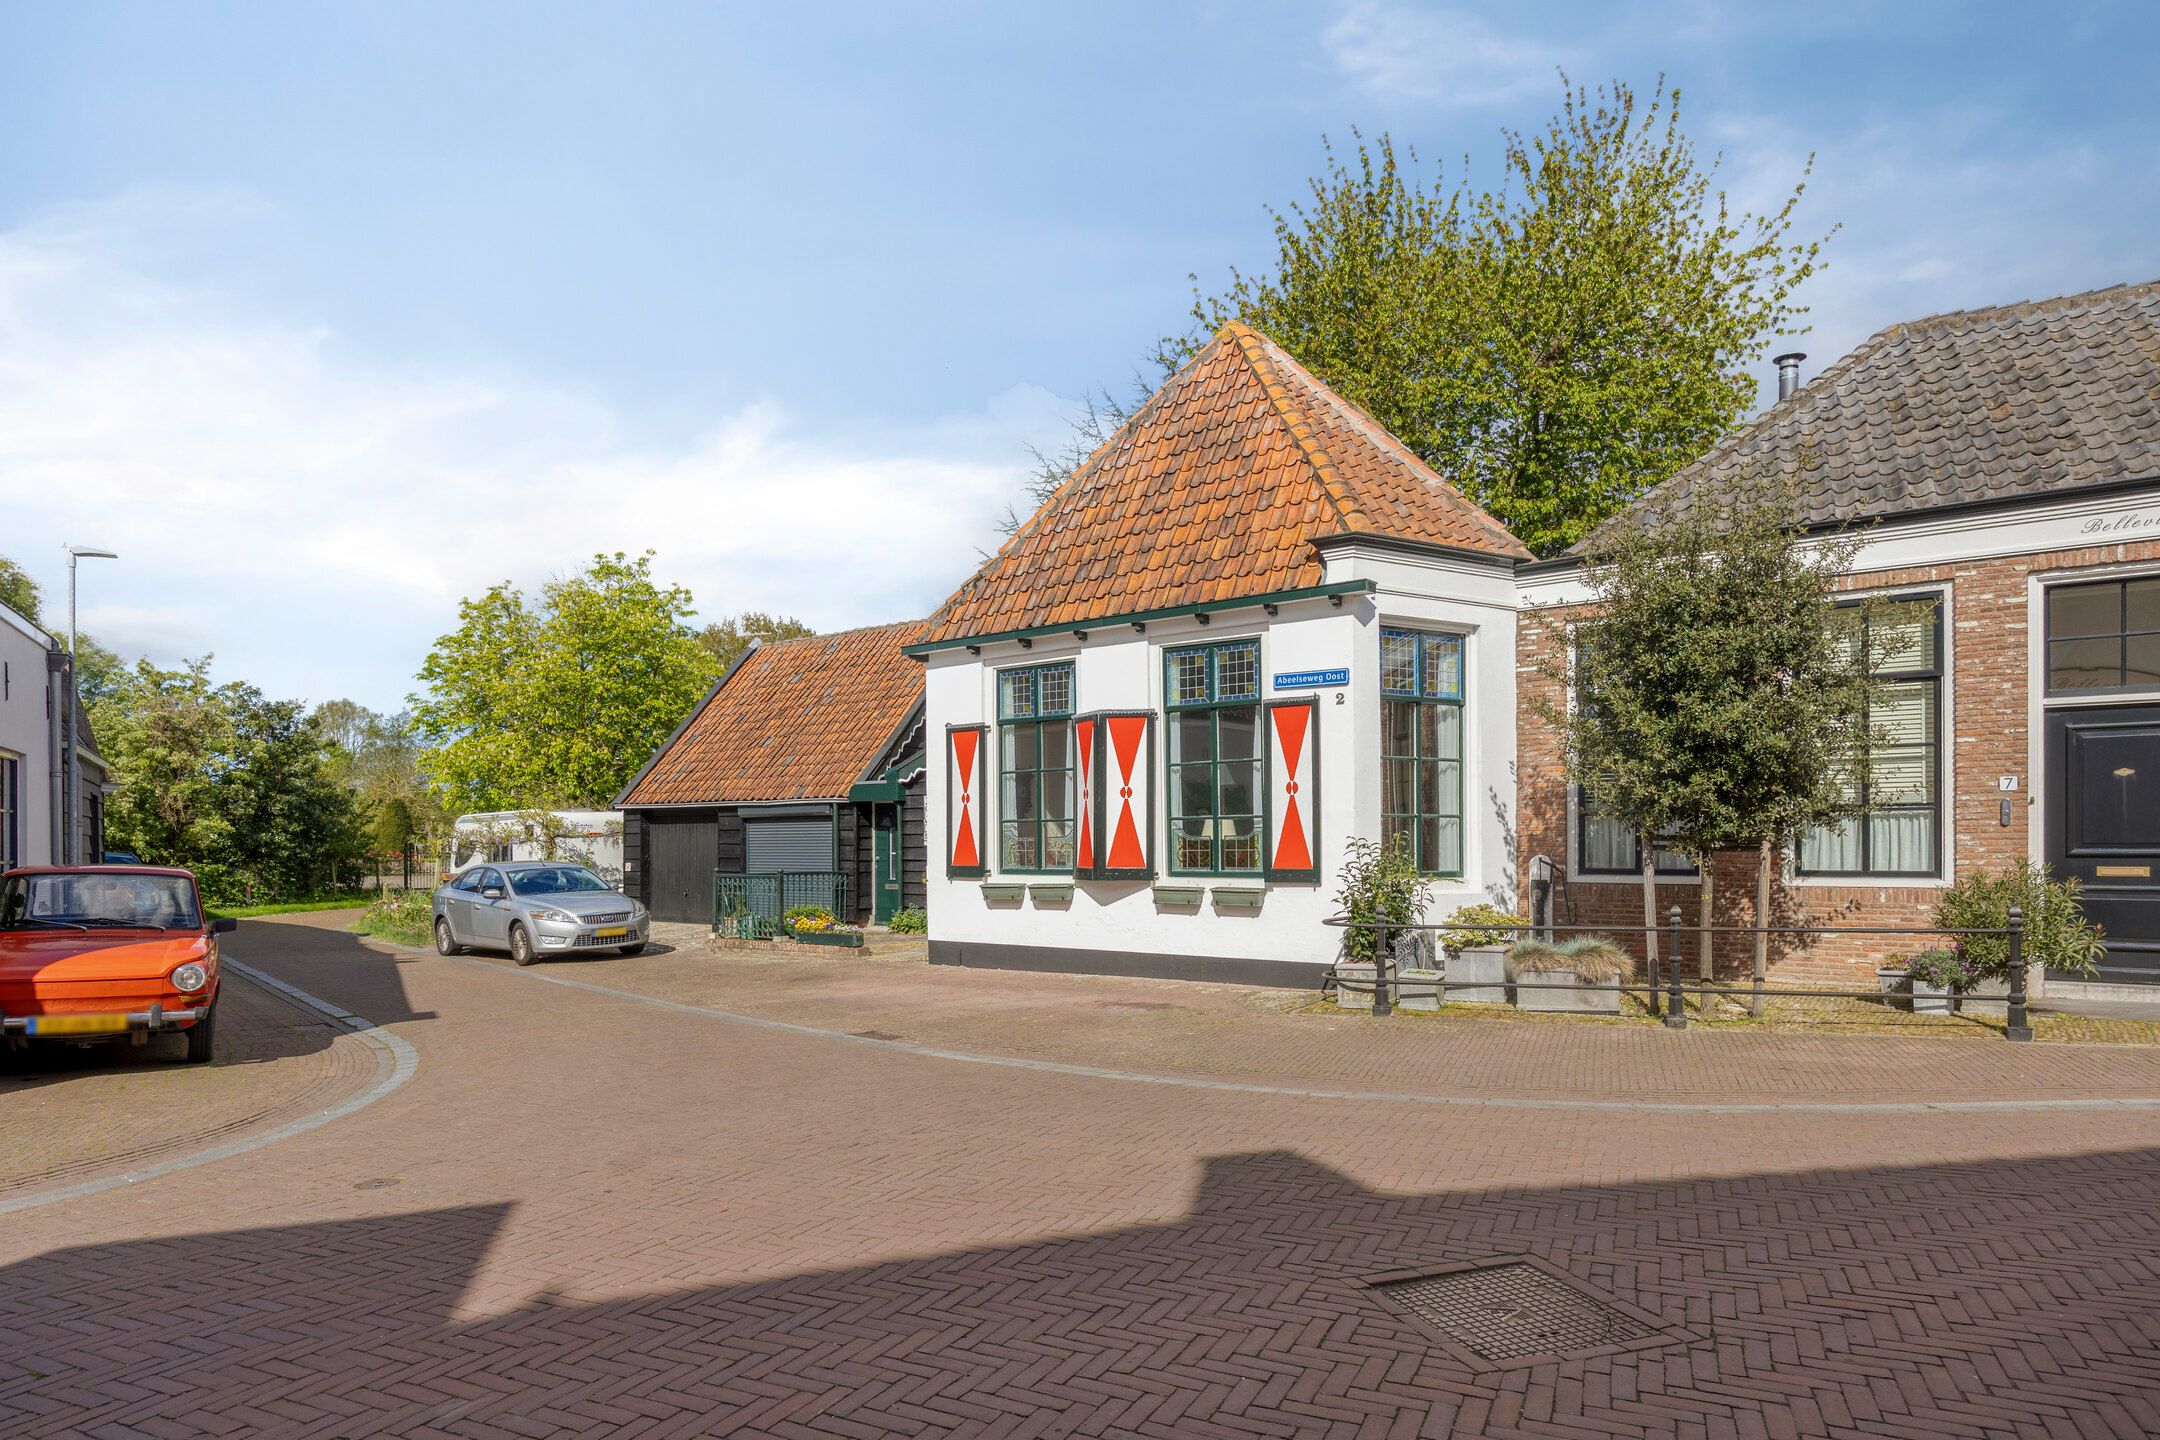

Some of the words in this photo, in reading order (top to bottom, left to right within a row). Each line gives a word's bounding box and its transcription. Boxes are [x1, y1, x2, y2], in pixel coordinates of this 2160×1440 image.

[1277, 674, 1323, 684] Abeelseweg
[1325, 672, 1345, 681] Oost
[1335, 692, 1345, 705] 2
[2004, 777, 2013, 789] 7
